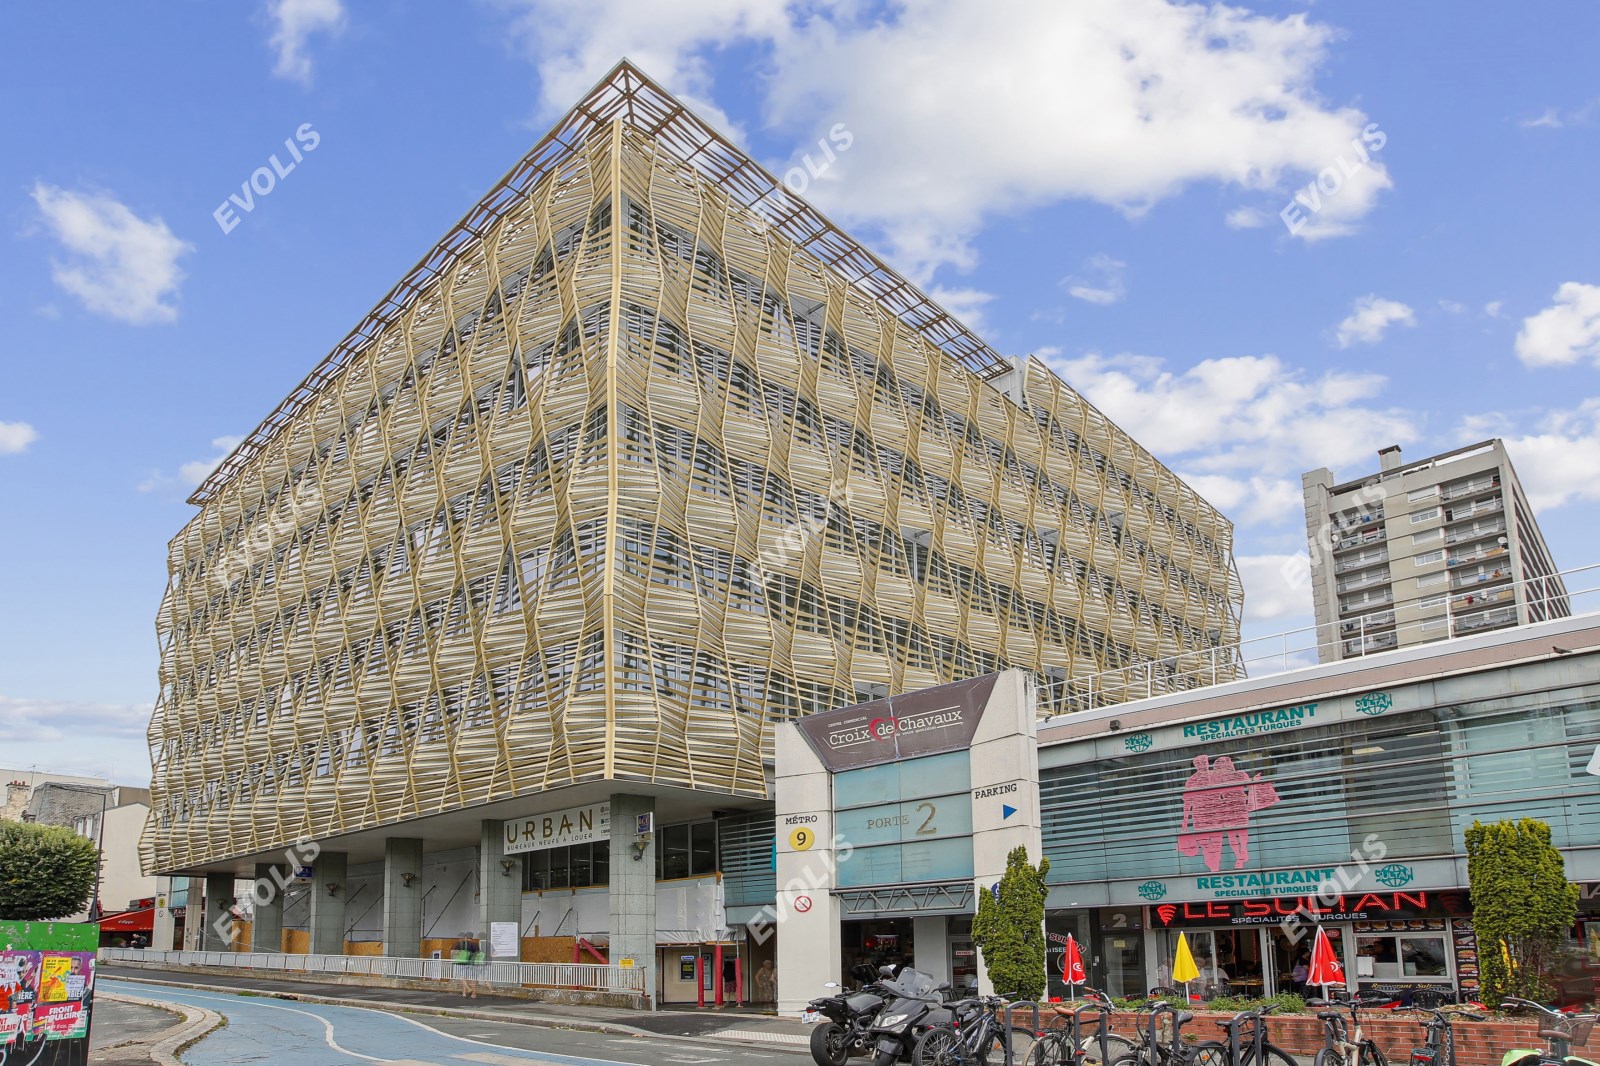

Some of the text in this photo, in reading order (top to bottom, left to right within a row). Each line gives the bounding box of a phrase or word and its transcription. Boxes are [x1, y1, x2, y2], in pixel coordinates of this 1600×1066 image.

[1355, 694, 1392, 712] SULTAN
[829, 710, 962, 745] Croix de Chavaux
[1183, 704, 1318, 738] RESTAURANT
[1258, 720, 1302, 733] TURQUES
[974, 783, 1017, 800] PARKING
[506, 809, 592, 843] URBAN
[785, 814, 817, 825] MÉTRO
[867, 802, 937, 836] PORTE 2
[507, 842, 535, 852] BUREAUX
[539, 838, 559, 846] NEUFS
[571, 832, 593, 841] LOUER
[797, 831, 806, 846] 9
[1197, 868, 1335, 890] RESTAURANT
[1375, 866, 1413, 882] SULTAN
[1273, 885, 1318, 894] TURQUES
[1184, 901, 1231, 919] LE
[1312, 912, 1367, 921] TURQUES
[1112, 913, 1127, 928] 2
[48, 1005, 75, 1015] FRONT
